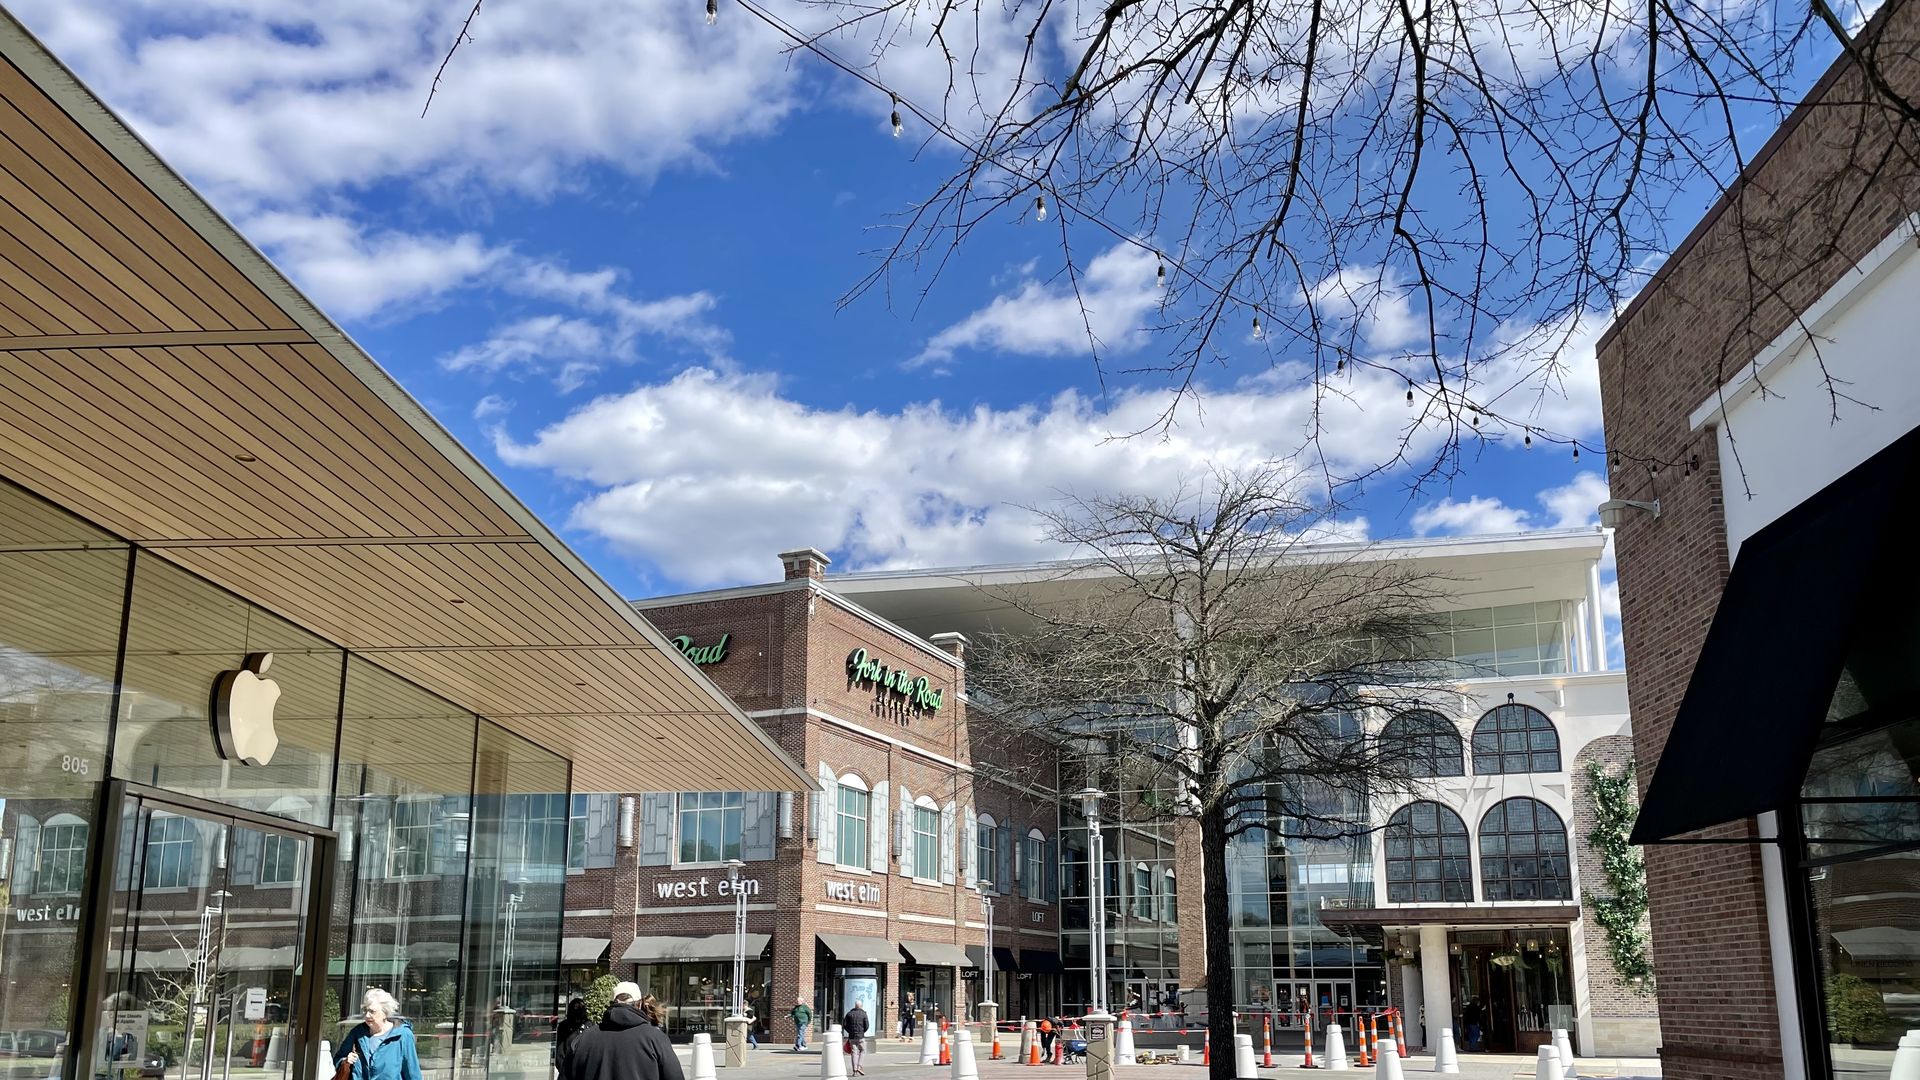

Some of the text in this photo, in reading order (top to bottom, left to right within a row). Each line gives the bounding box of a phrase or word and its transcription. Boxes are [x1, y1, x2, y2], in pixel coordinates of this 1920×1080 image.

[853, 647, 944, 709] Fork in the Road
[61, 755, 89, 775] 805
[657, 876, 709, 898] west
[827, 880, 880, 903] west elm
[17, 904, 51, 922] west
[1031, 911, 1045, 923] LOFT
[686, 1023, 717, 1031] west elm
